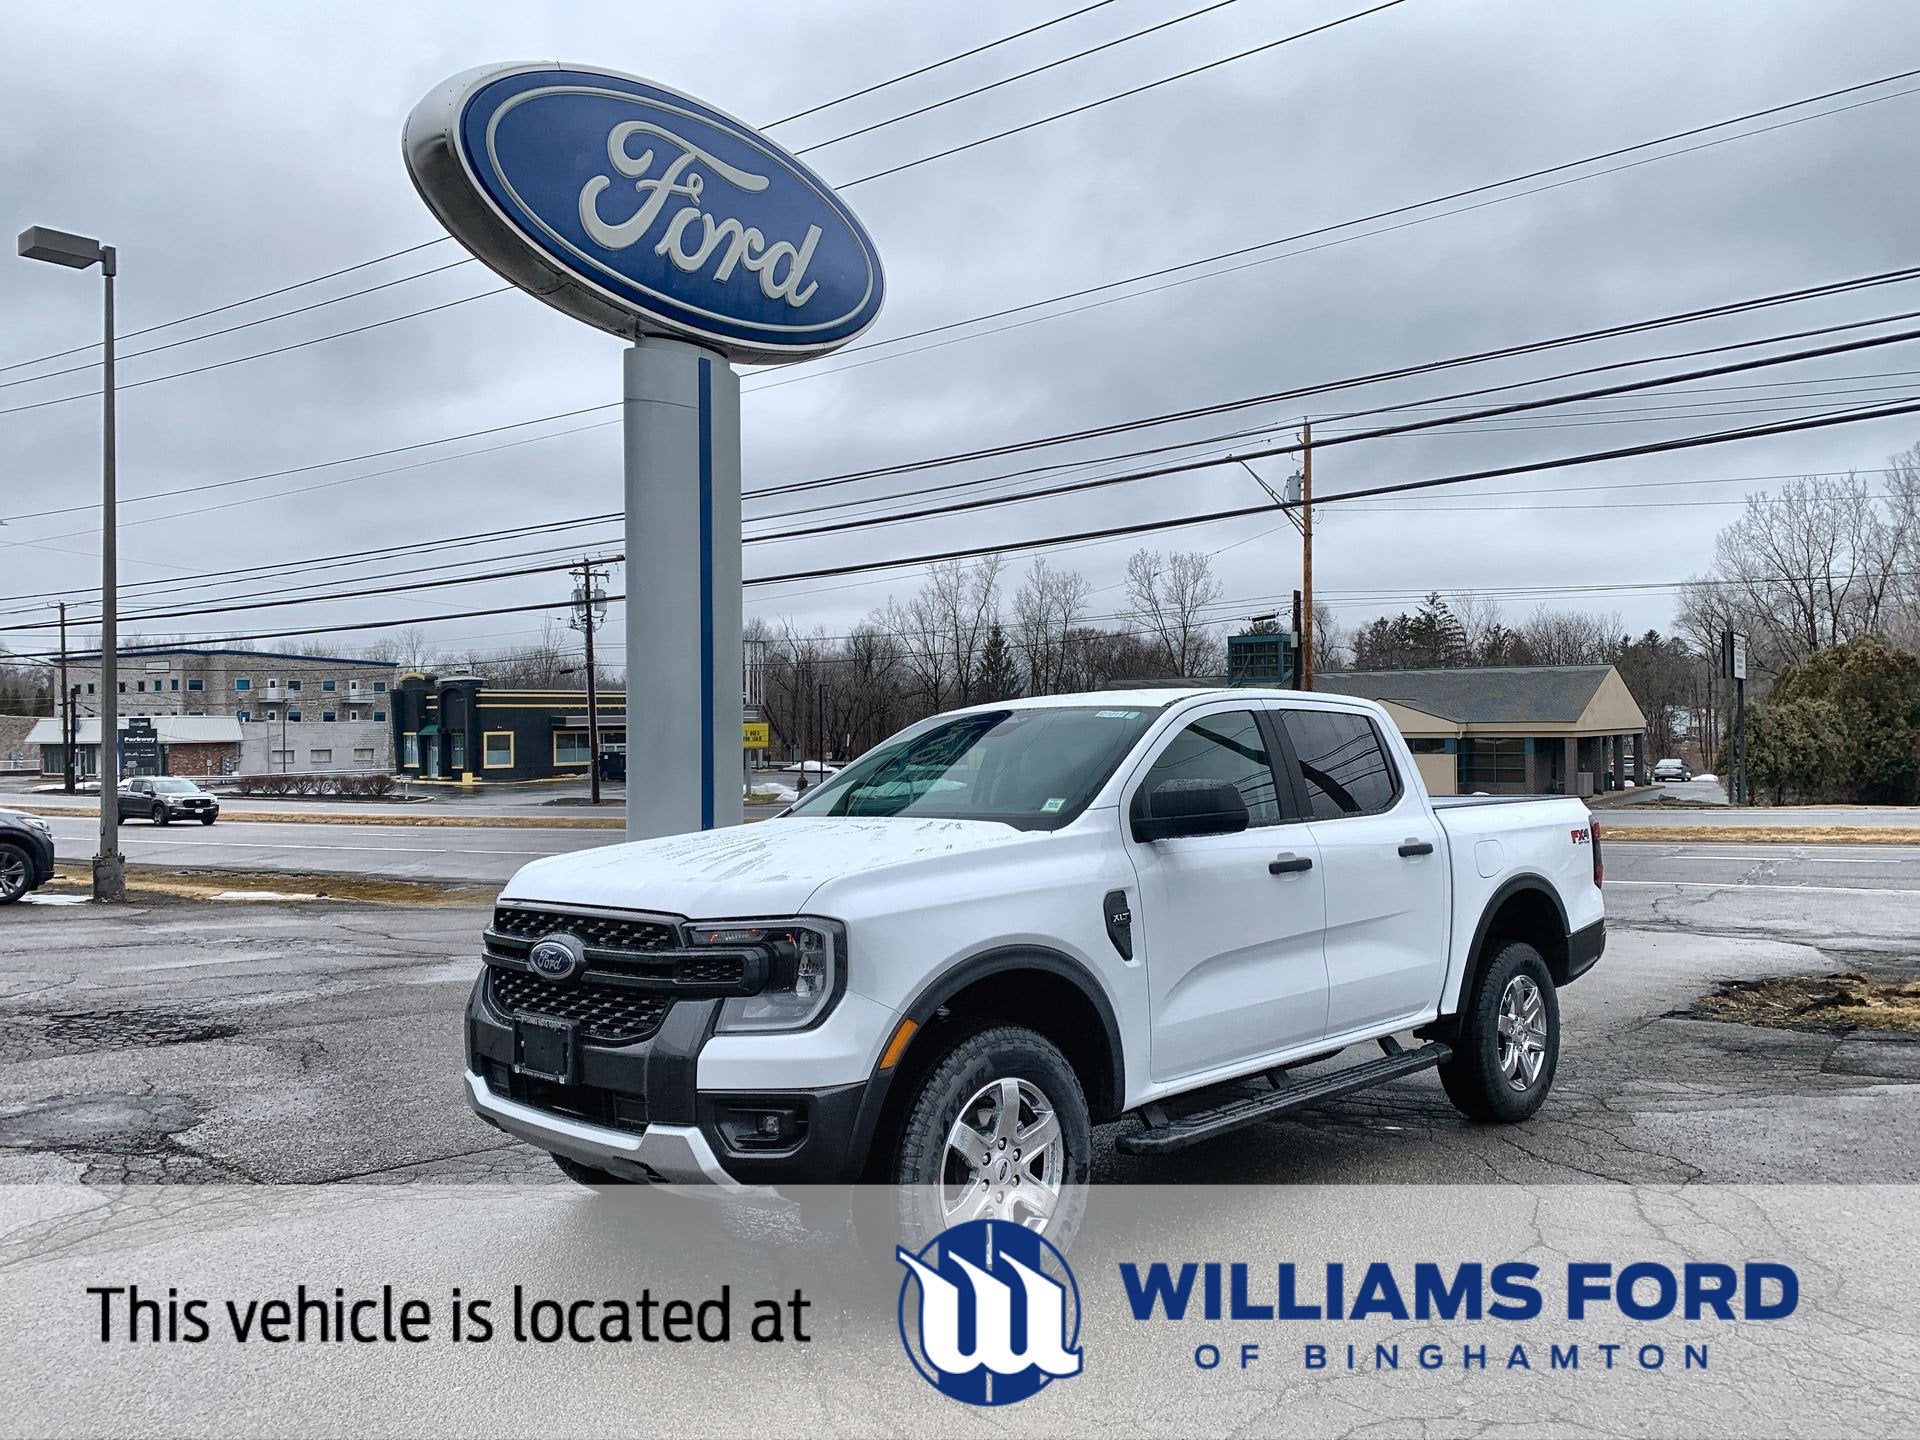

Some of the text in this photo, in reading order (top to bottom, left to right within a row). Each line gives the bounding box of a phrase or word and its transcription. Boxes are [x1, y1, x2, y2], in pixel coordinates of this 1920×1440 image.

[578, 119, 824, 309] Ford
[1570, 828, 1590, 844] FX4
[1112, 911, 1130, 923] XLT
[537, 948, 563, 971] Ford
